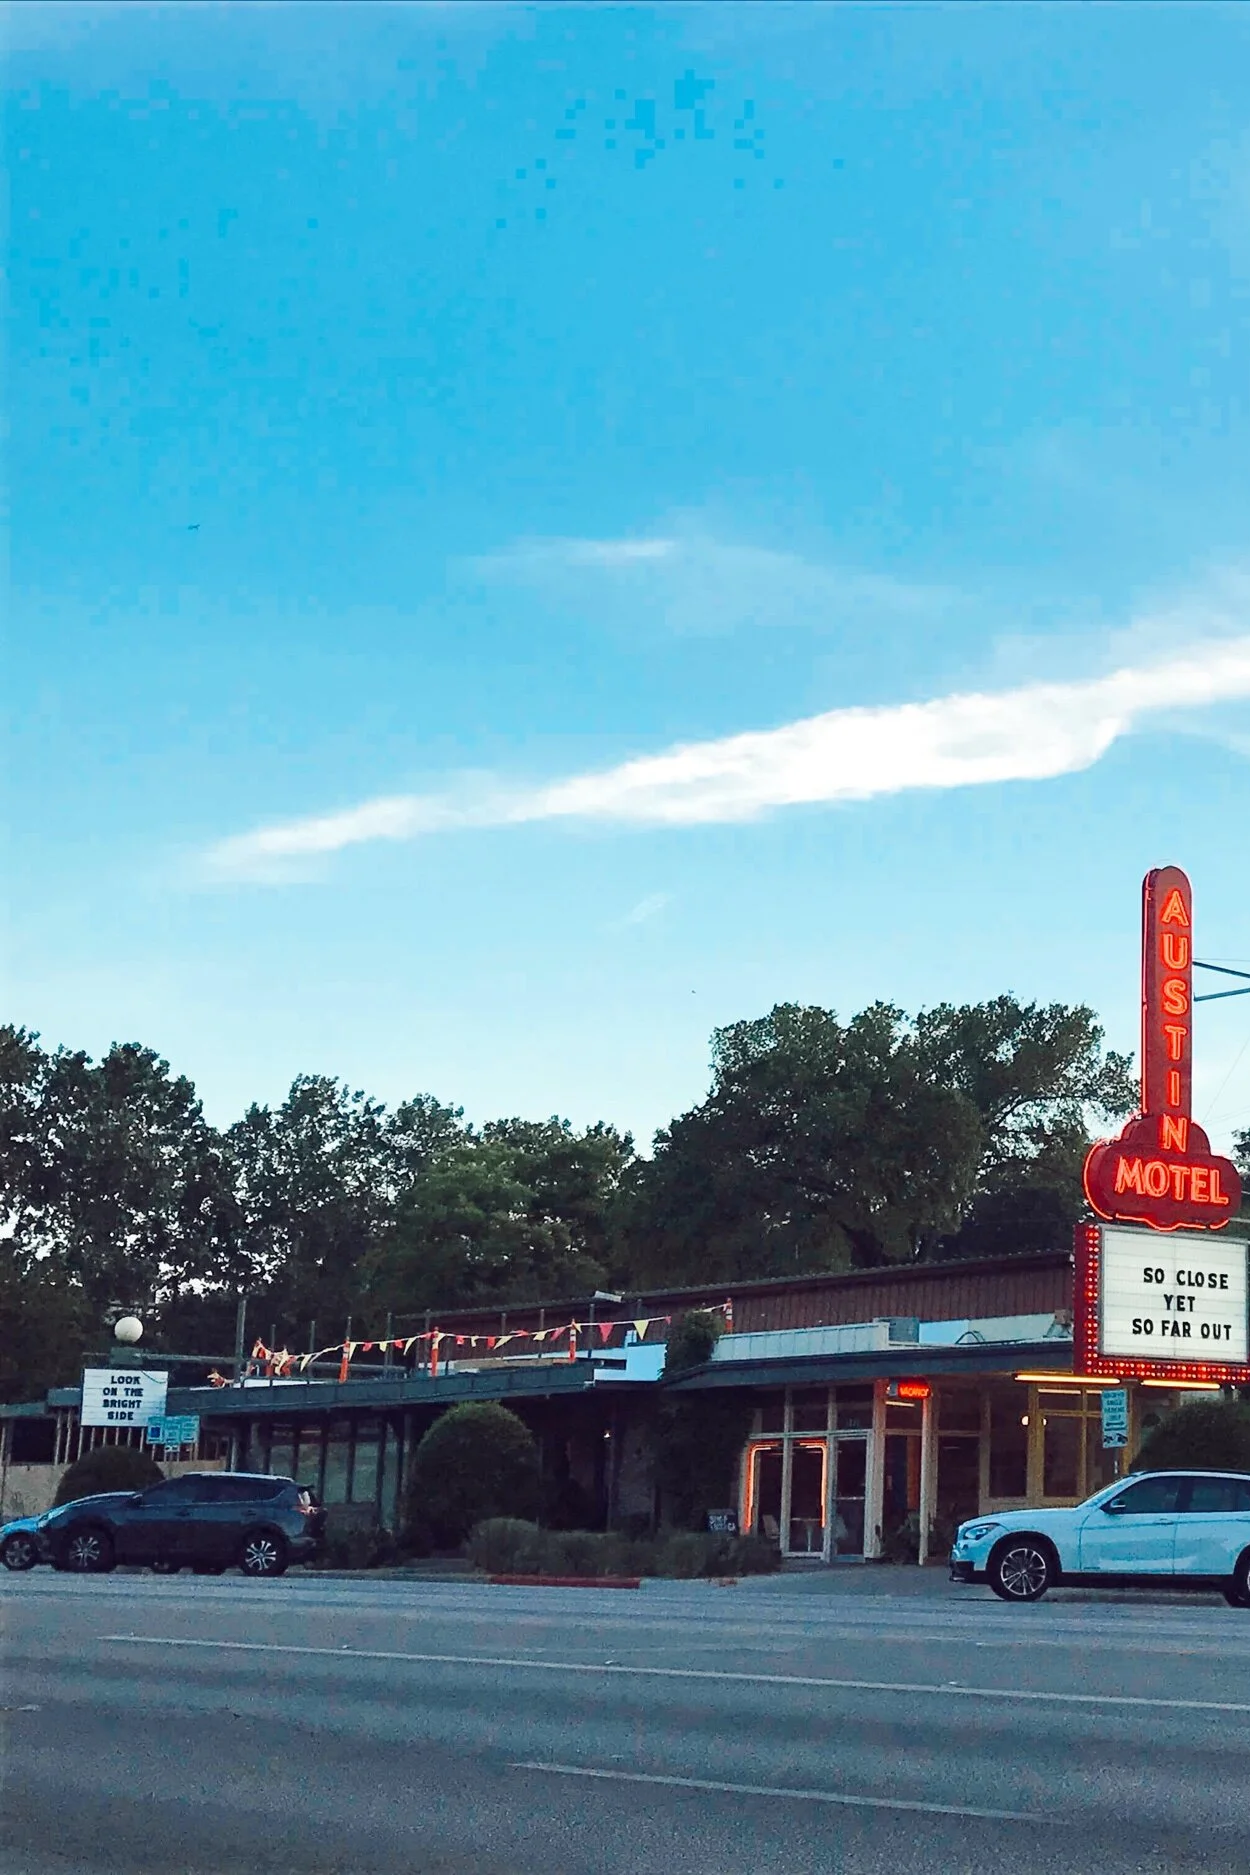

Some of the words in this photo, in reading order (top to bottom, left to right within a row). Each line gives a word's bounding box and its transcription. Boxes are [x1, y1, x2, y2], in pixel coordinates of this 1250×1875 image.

[1161, 889, 1189, 1153] AUSTIN
[1114, 1156, 1229, 1206] MOTEL
[1143, 1267, 1165, 1284] SO
[1176, 1270, 1229, 1290] CLOSE
[1163, 1294, 1196, 1312] YET
[1132, 1318, 1154, 1335] SO
[1161, 1320, 1192, 1338] FAR
[1200, 1323, 1232, 1341] OUT
[110, 1375, 142, 1385] LOOK
[102, 1387, 118, 1396] ON
[124, 1387, 144, 1397] THE
[102, 1399, 142, 1409] BRIGHT
[107, 1411, 134, 1421] SIDE
